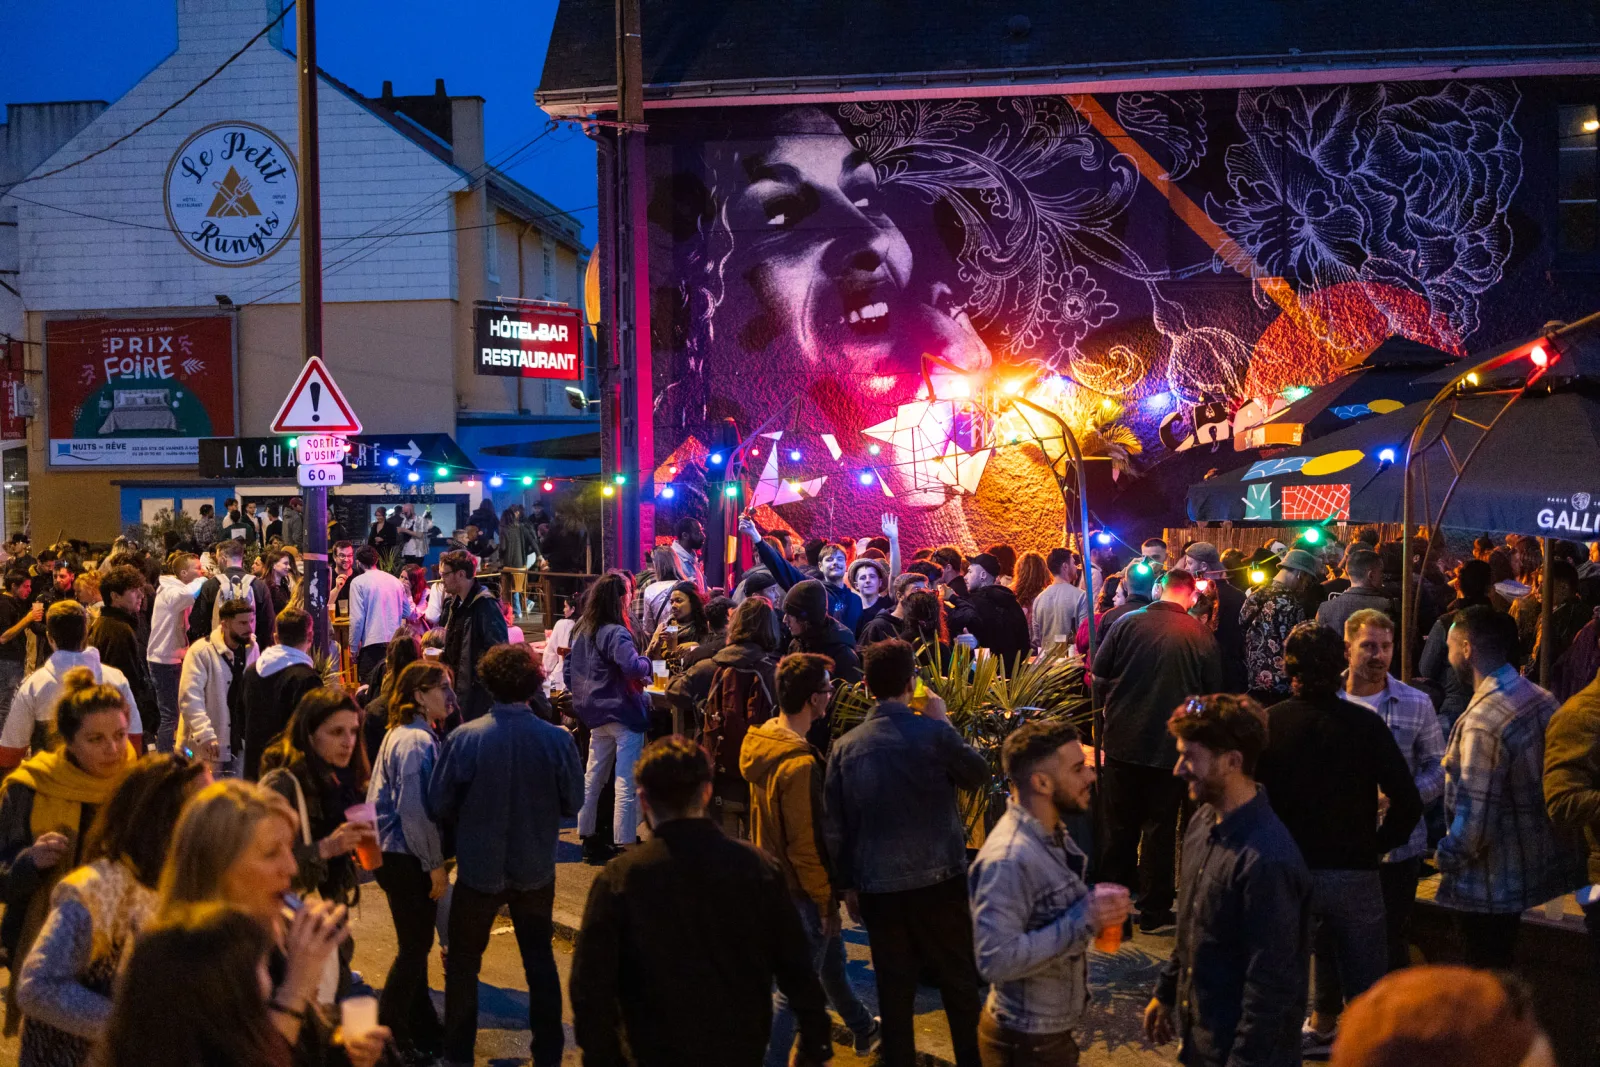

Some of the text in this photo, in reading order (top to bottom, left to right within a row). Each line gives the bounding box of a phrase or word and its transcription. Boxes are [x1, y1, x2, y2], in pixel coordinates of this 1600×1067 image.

[181, 132, 287, 185] Le Petit
[191, 211, 280, 255] Rungis
[110, 336, 174, 353] PRIX
[482, 348, 577, 370] RESTAURANT
[105, 441, 127, 450] RÊVE
[307, 437, 340, 449] SORTIE
[224, 446, 245, 468] LA
[305, 449, 341, 461] D'USINE
[308, 469, 326, 481] 60
